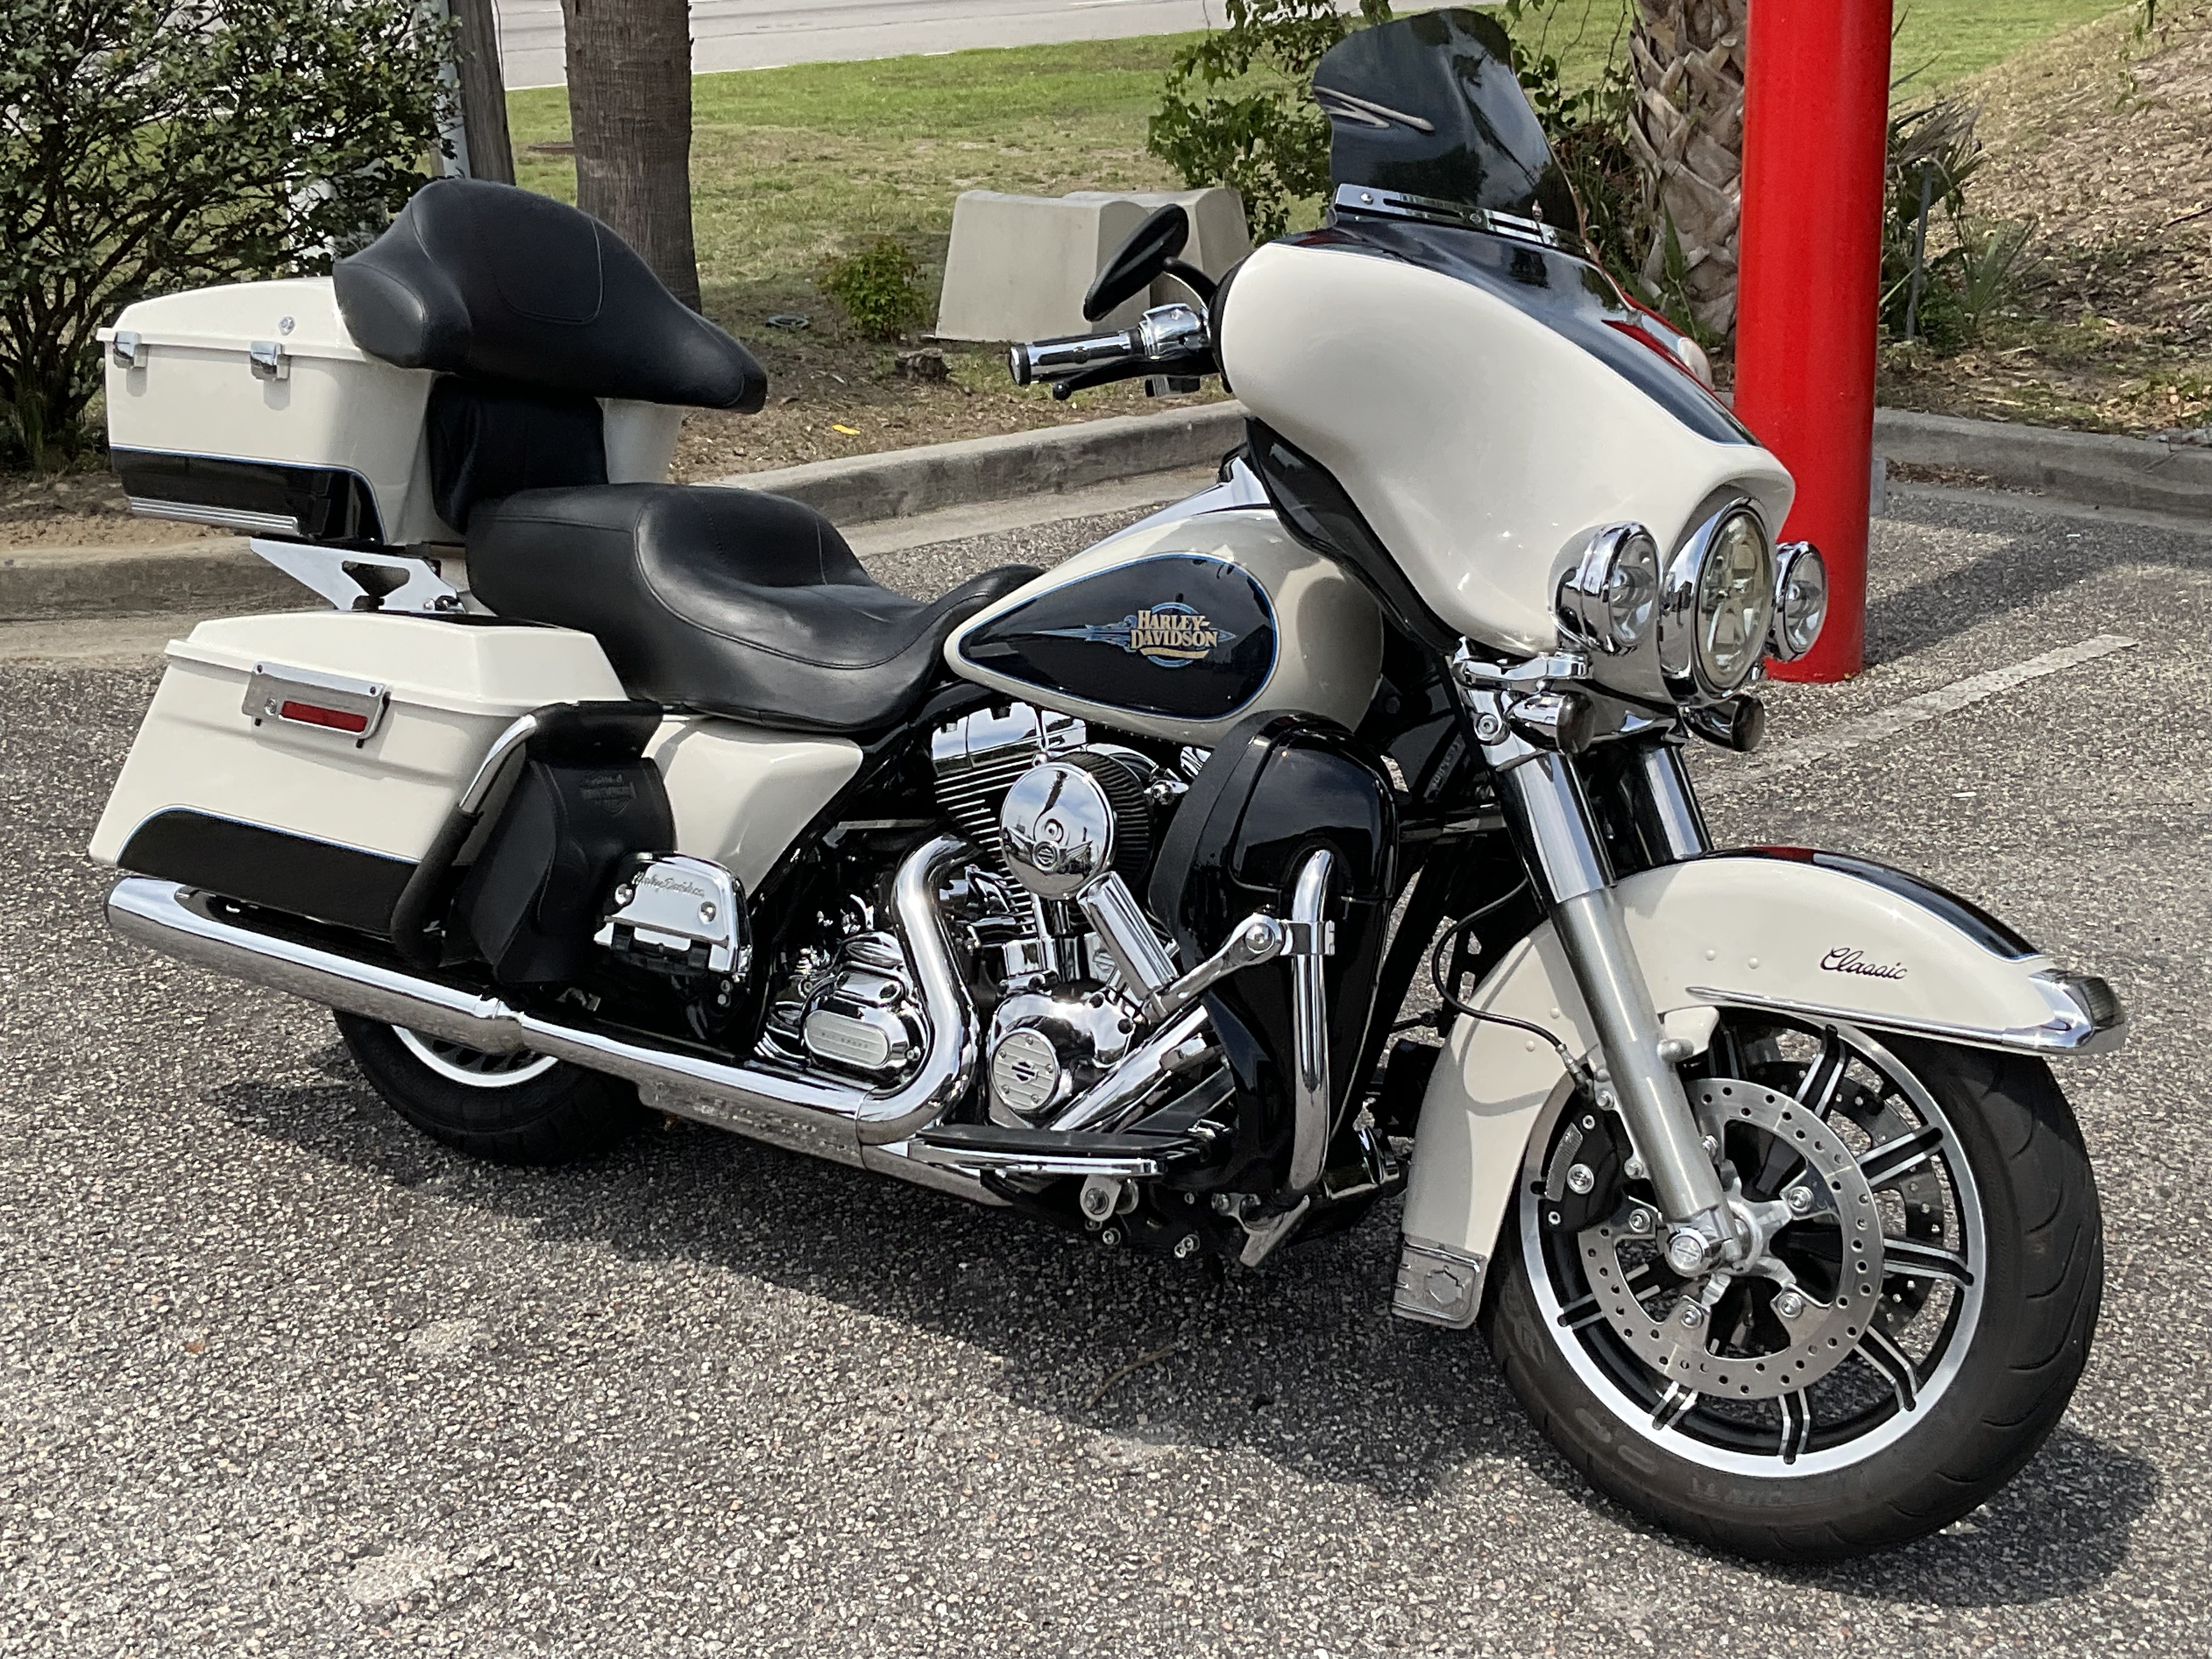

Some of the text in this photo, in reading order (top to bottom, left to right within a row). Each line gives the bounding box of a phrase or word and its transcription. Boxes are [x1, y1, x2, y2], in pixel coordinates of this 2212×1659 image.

[1137, 610, 1210, 631] HARLEY-
[1131, 629, 1218, 648] DAVIDSON
[1820, 947, 1908, 980] Classic
